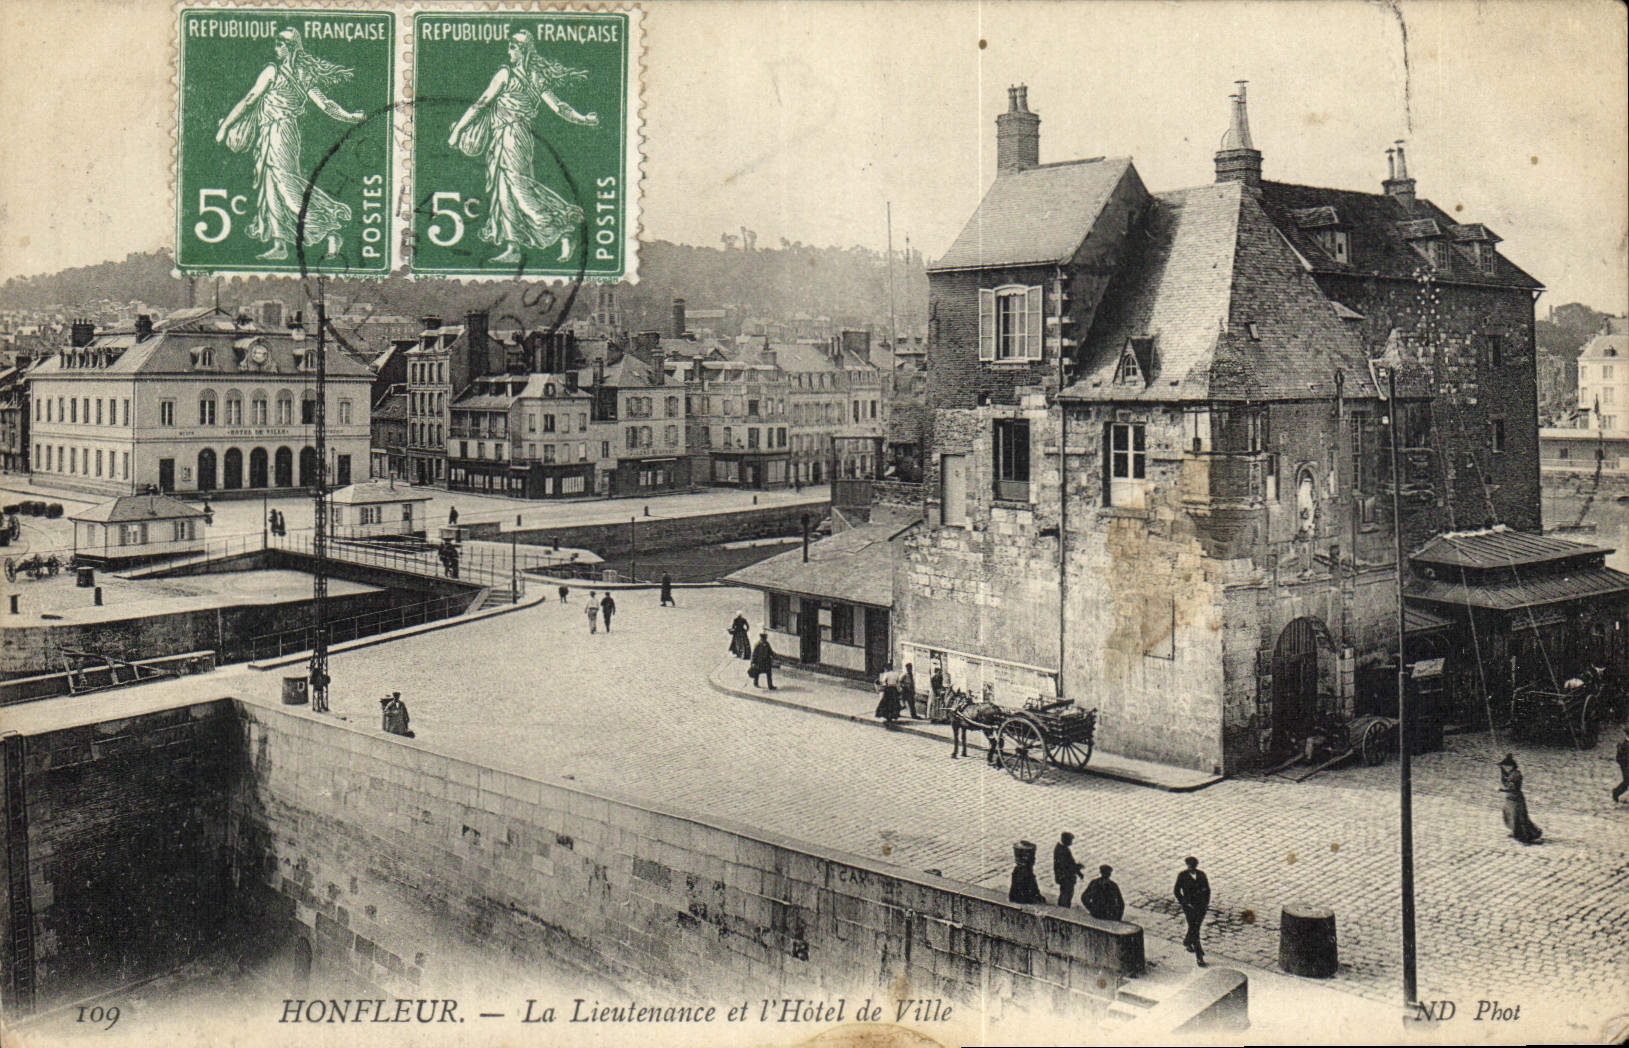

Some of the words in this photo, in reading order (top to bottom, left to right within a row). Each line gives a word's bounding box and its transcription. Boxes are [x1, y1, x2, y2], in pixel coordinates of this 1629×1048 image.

[304, 21, 386, 42] FRANÇAISE
[537, 24, 618, 44] FRANÇAISE
[363, 174, 383, 258] POSTES
[596, 176, 616, 260] POSTES
